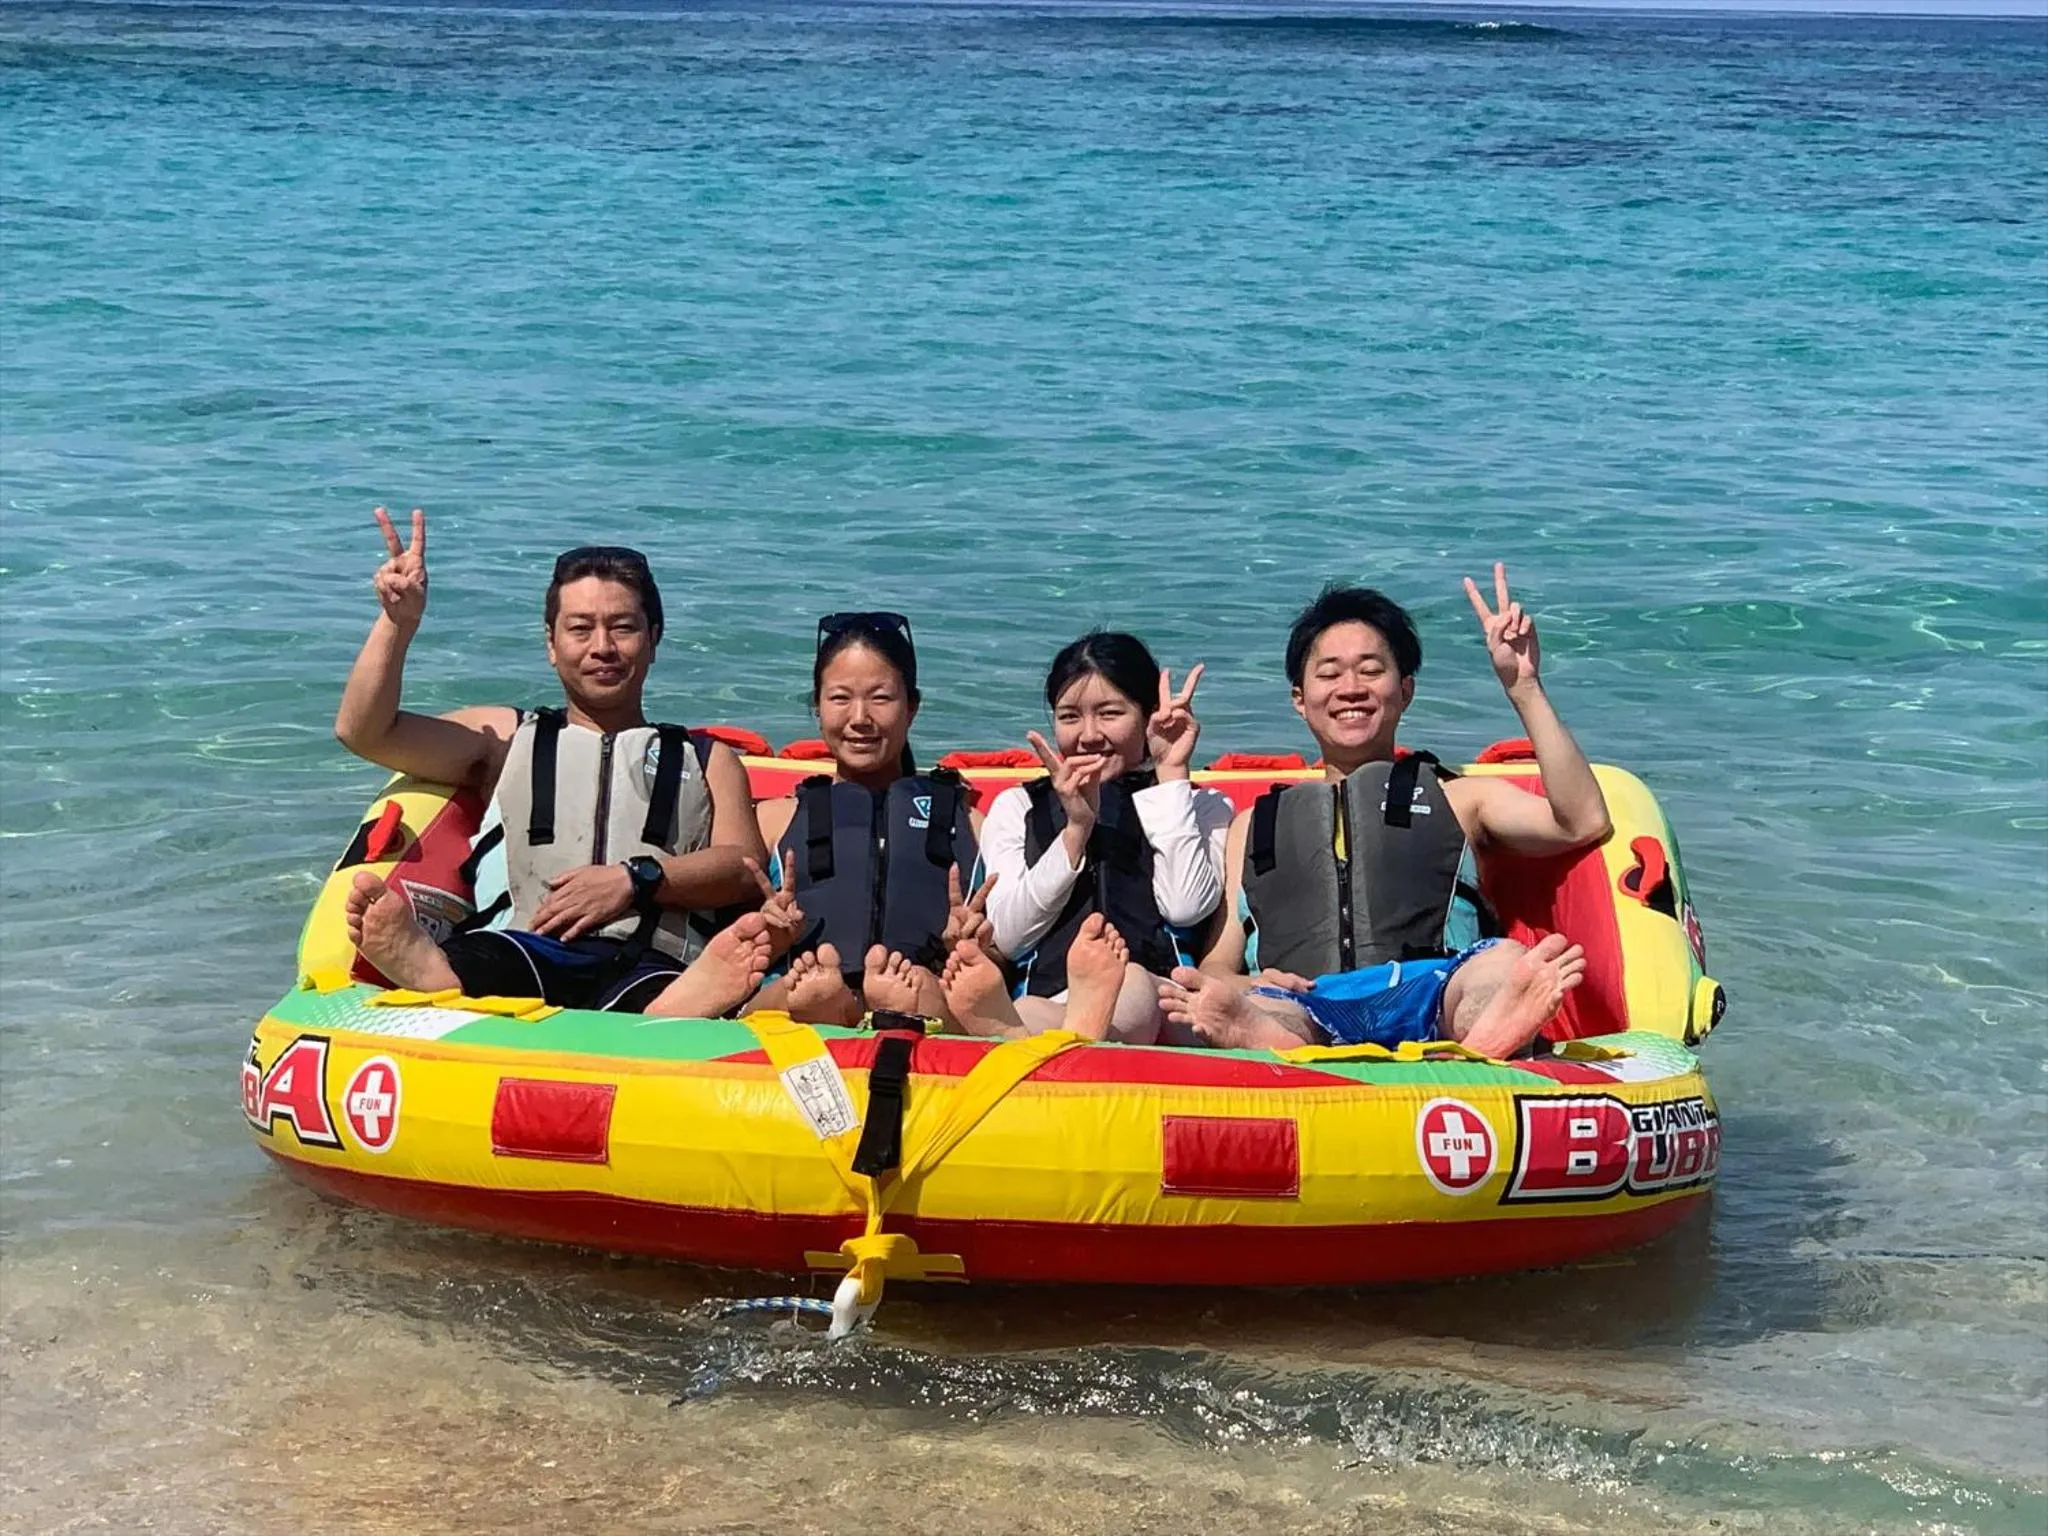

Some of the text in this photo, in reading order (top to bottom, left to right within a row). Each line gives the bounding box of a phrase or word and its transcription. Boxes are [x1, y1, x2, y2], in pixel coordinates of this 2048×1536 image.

[359, 1097, 382, 1111] FUN
[1631, 1101, 1706, 1133] GIANT
[1442, 1137, 1474, 1151] FUN
